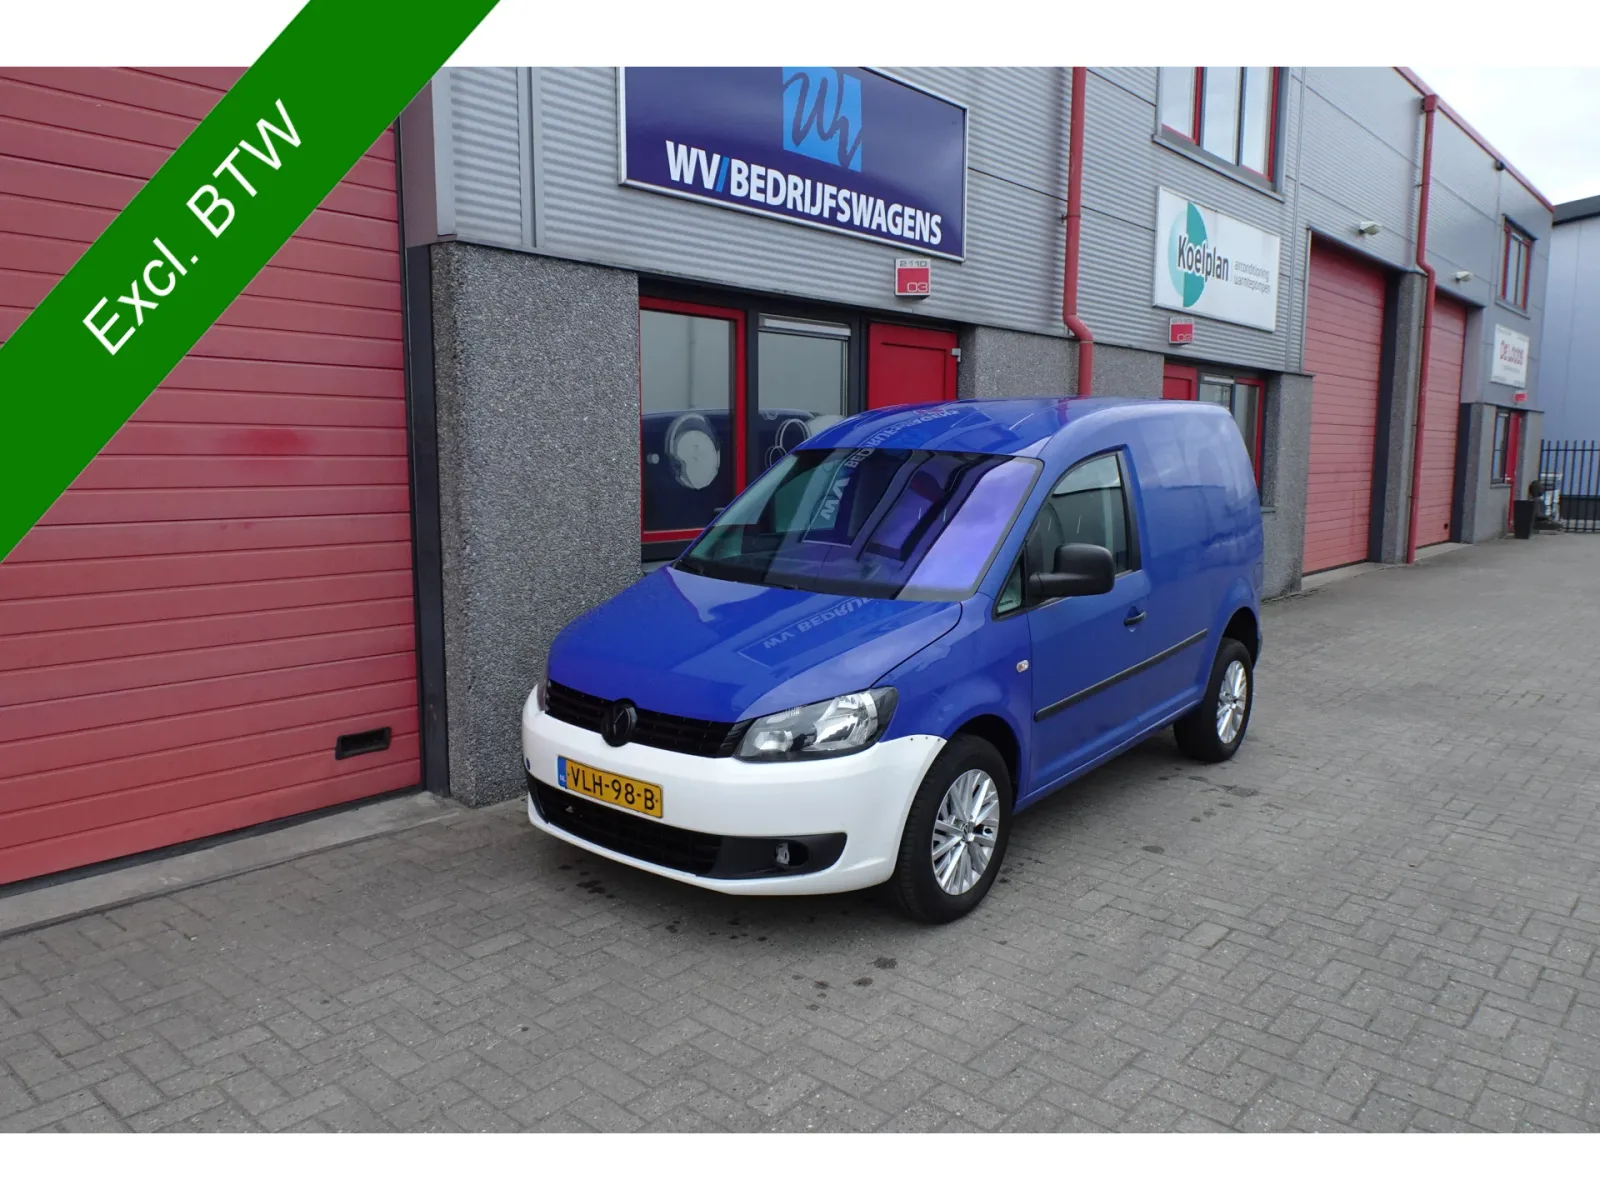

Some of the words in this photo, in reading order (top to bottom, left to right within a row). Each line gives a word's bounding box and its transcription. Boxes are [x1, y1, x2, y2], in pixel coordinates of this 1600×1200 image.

[1177, 234, 1229, 283] Koelplan
[907, 282, 928, 292] 03
[570, 766, 655, 810] VLH-98-B
